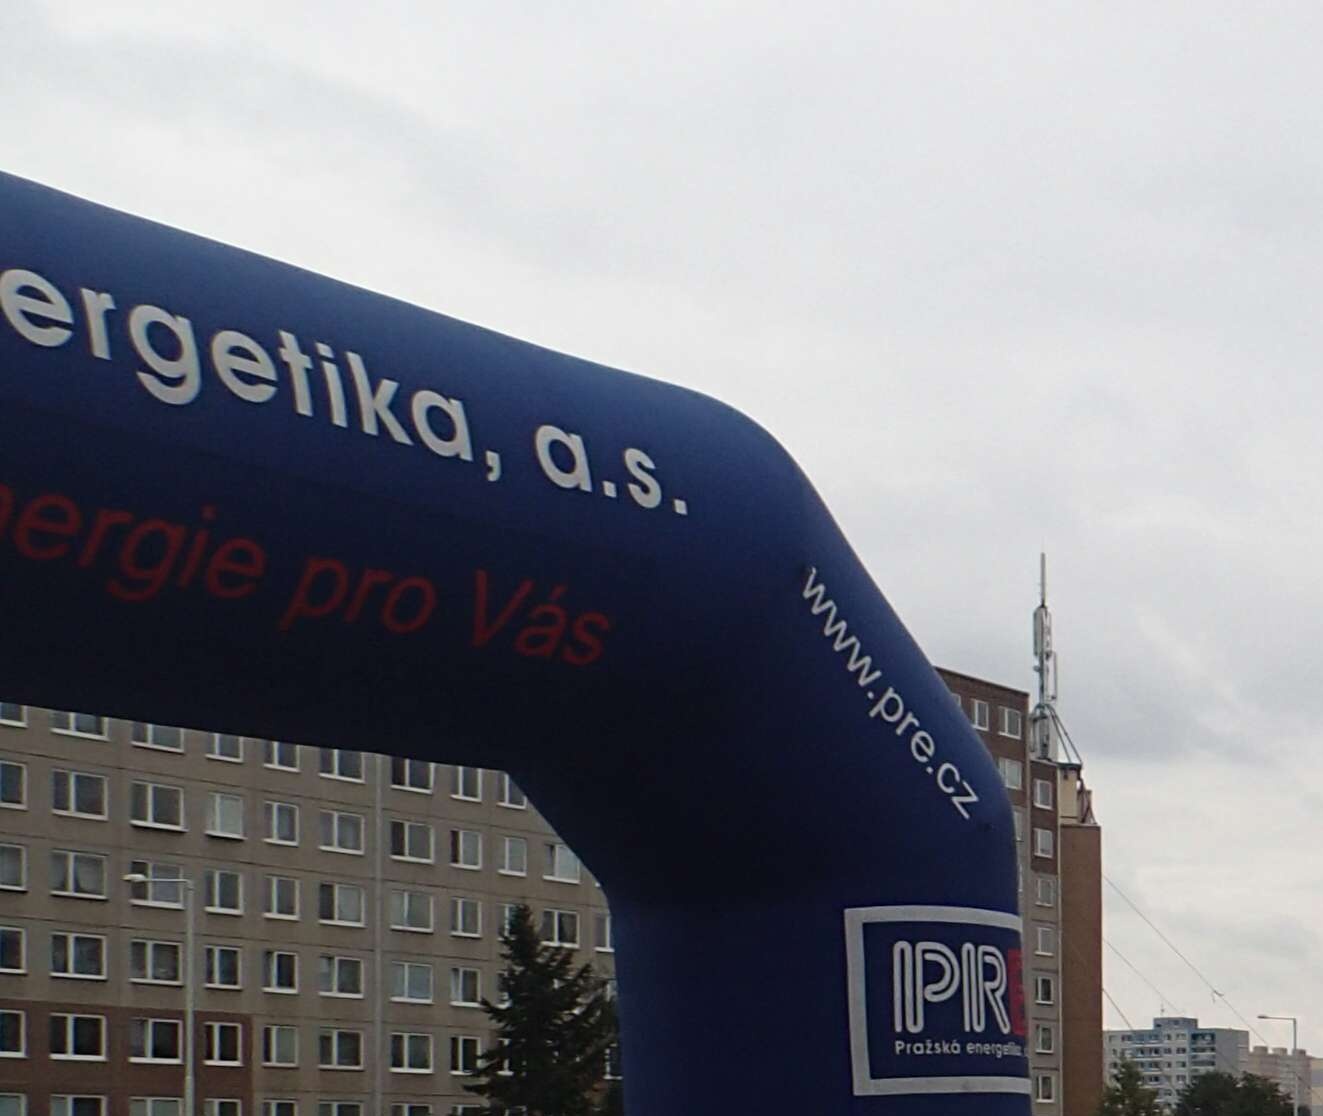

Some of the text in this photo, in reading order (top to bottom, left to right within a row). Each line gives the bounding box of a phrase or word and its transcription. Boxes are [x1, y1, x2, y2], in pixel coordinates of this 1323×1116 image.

[535, 423, 688, 514] a.s.
[0, 484, 615, 667] ergie pro Vás
[802, 566, 980, 820] www.pre.cz
[894, 1038, 961, 1056] Pražská
